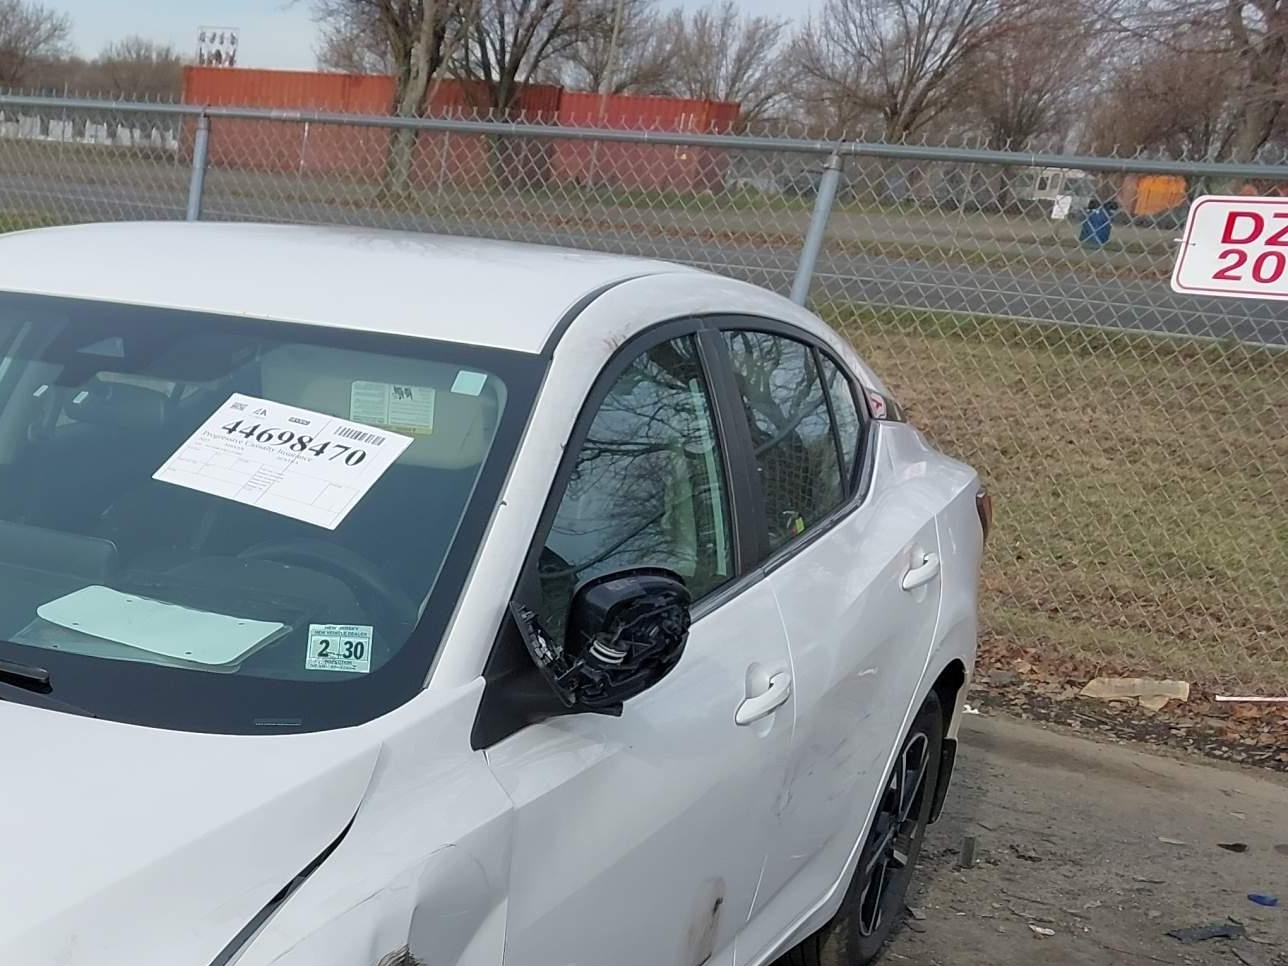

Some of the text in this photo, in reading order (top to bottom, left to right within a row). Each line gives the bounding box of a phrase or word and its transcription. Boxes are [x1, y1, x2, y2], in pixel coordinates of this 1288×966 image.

[1212, 248, 1286, 284] 20
[222, 419, 367, 467] 44698470
[318, 639, 365, 660] 2 30
